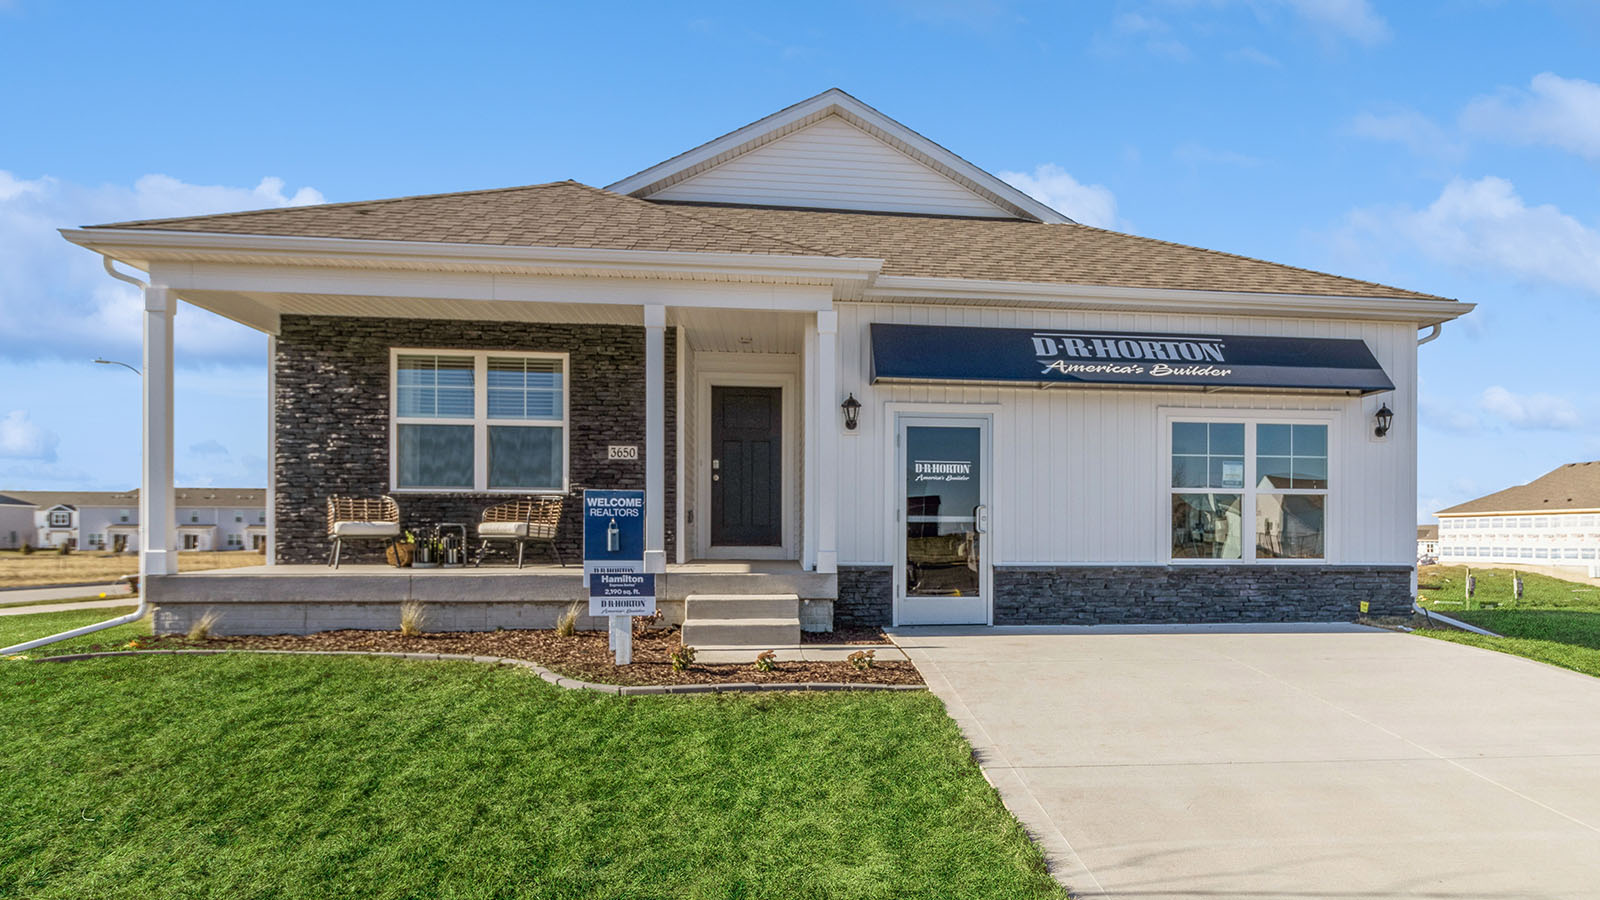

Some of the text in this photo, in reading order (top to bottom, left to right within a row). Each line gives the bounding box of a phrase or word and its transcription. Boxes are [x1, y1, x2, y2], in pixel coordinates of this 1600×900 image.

[1041, 359, 1232, 377] America's Builder
[610, 447, 636, 458] 3650
[587, 498, 642, 507] WELCOME
[590, 508, 639, 517] REALTORS
[601, 575, 644, 583] Hamilton
